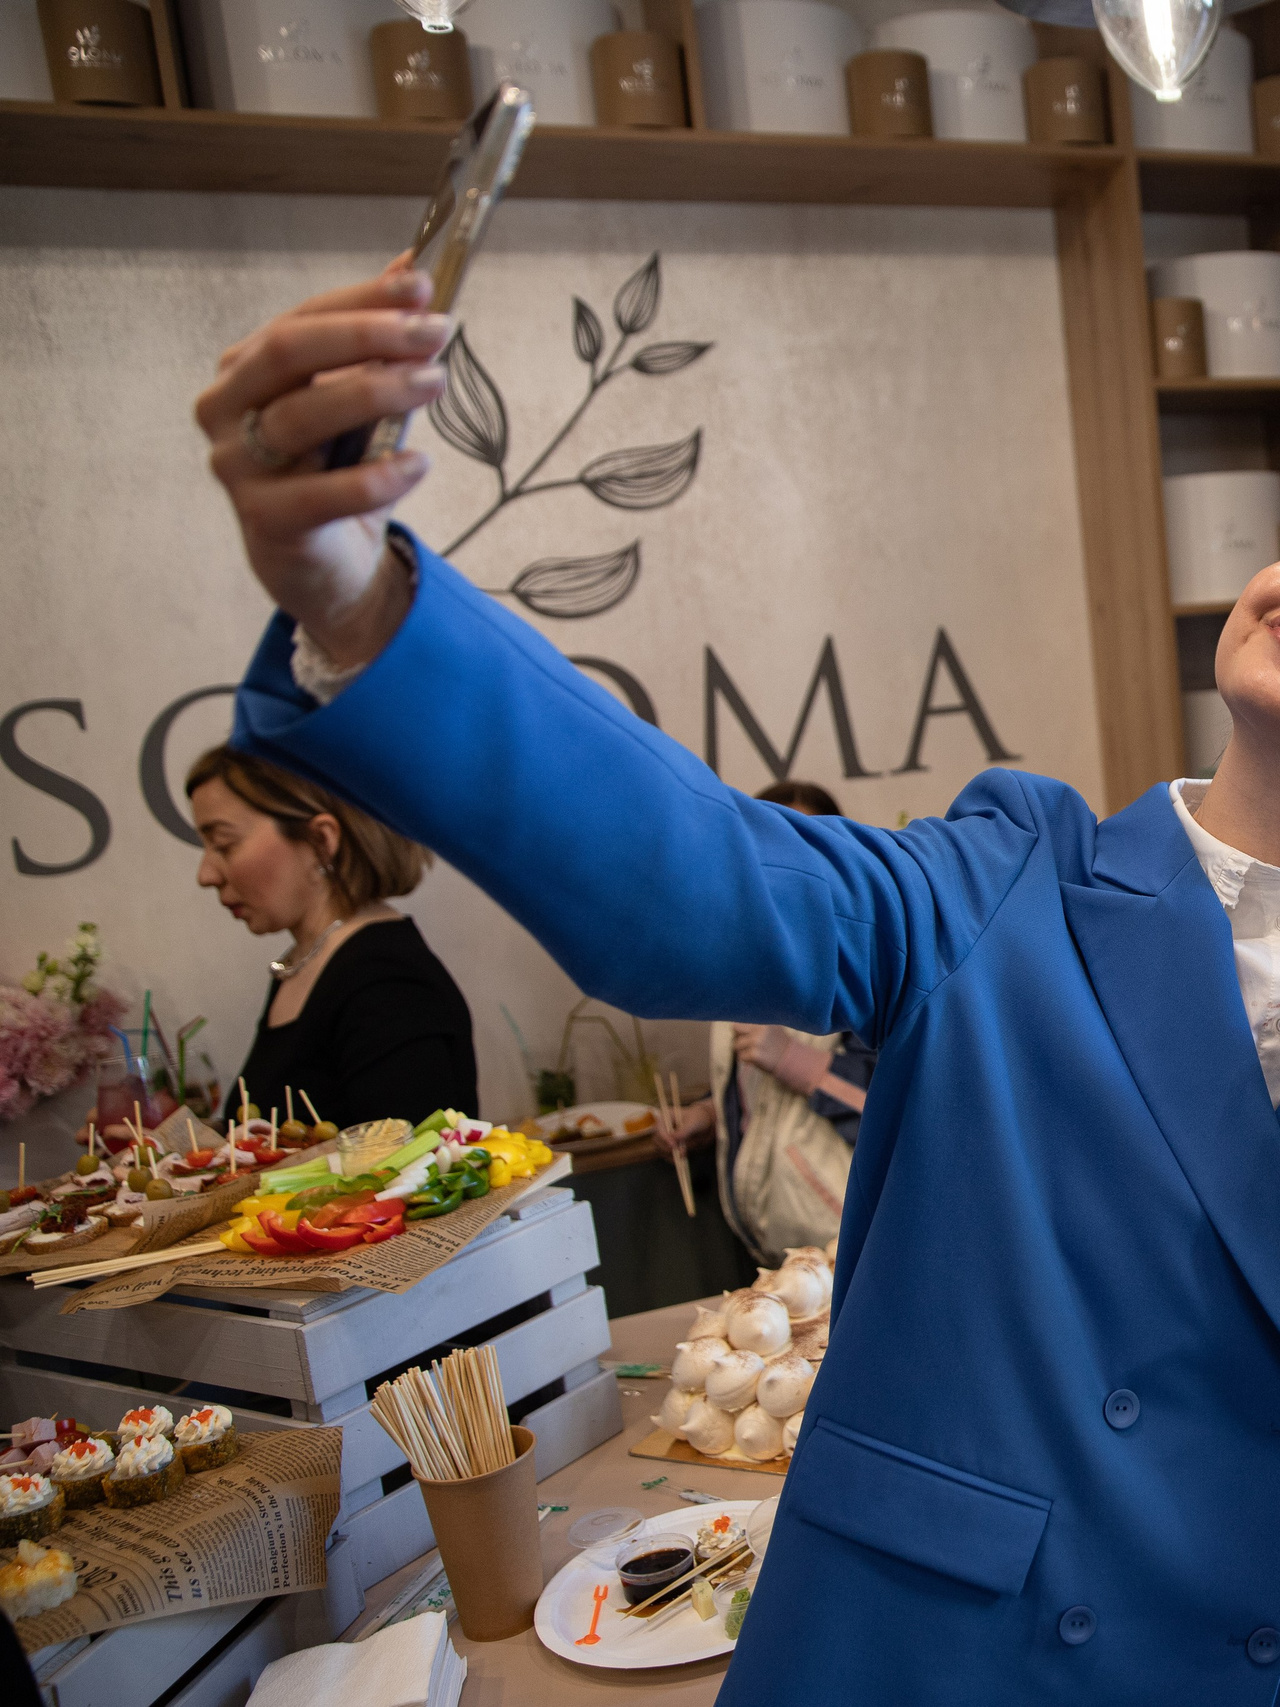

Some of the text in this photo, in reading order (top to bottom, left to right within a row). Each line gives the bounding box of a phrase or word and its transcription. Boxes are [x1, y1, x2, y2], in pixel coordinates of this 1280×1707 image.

[0, 627, 1022, 878] SMA
[369, 1279, 402, 1291] This
[267, 1494, 279, 1509] the
[273, 1511, 283, 1521] in
[264, 1521, 279, 1574] Belgium's
[277, 1524, 291, 1588] Perfection's
[174, 1551, 196, 1573] see
[159, 1567, 183, 1603] This
[189, 1578, 203, 1599] us
[272, 1577, 281, 1590] In
